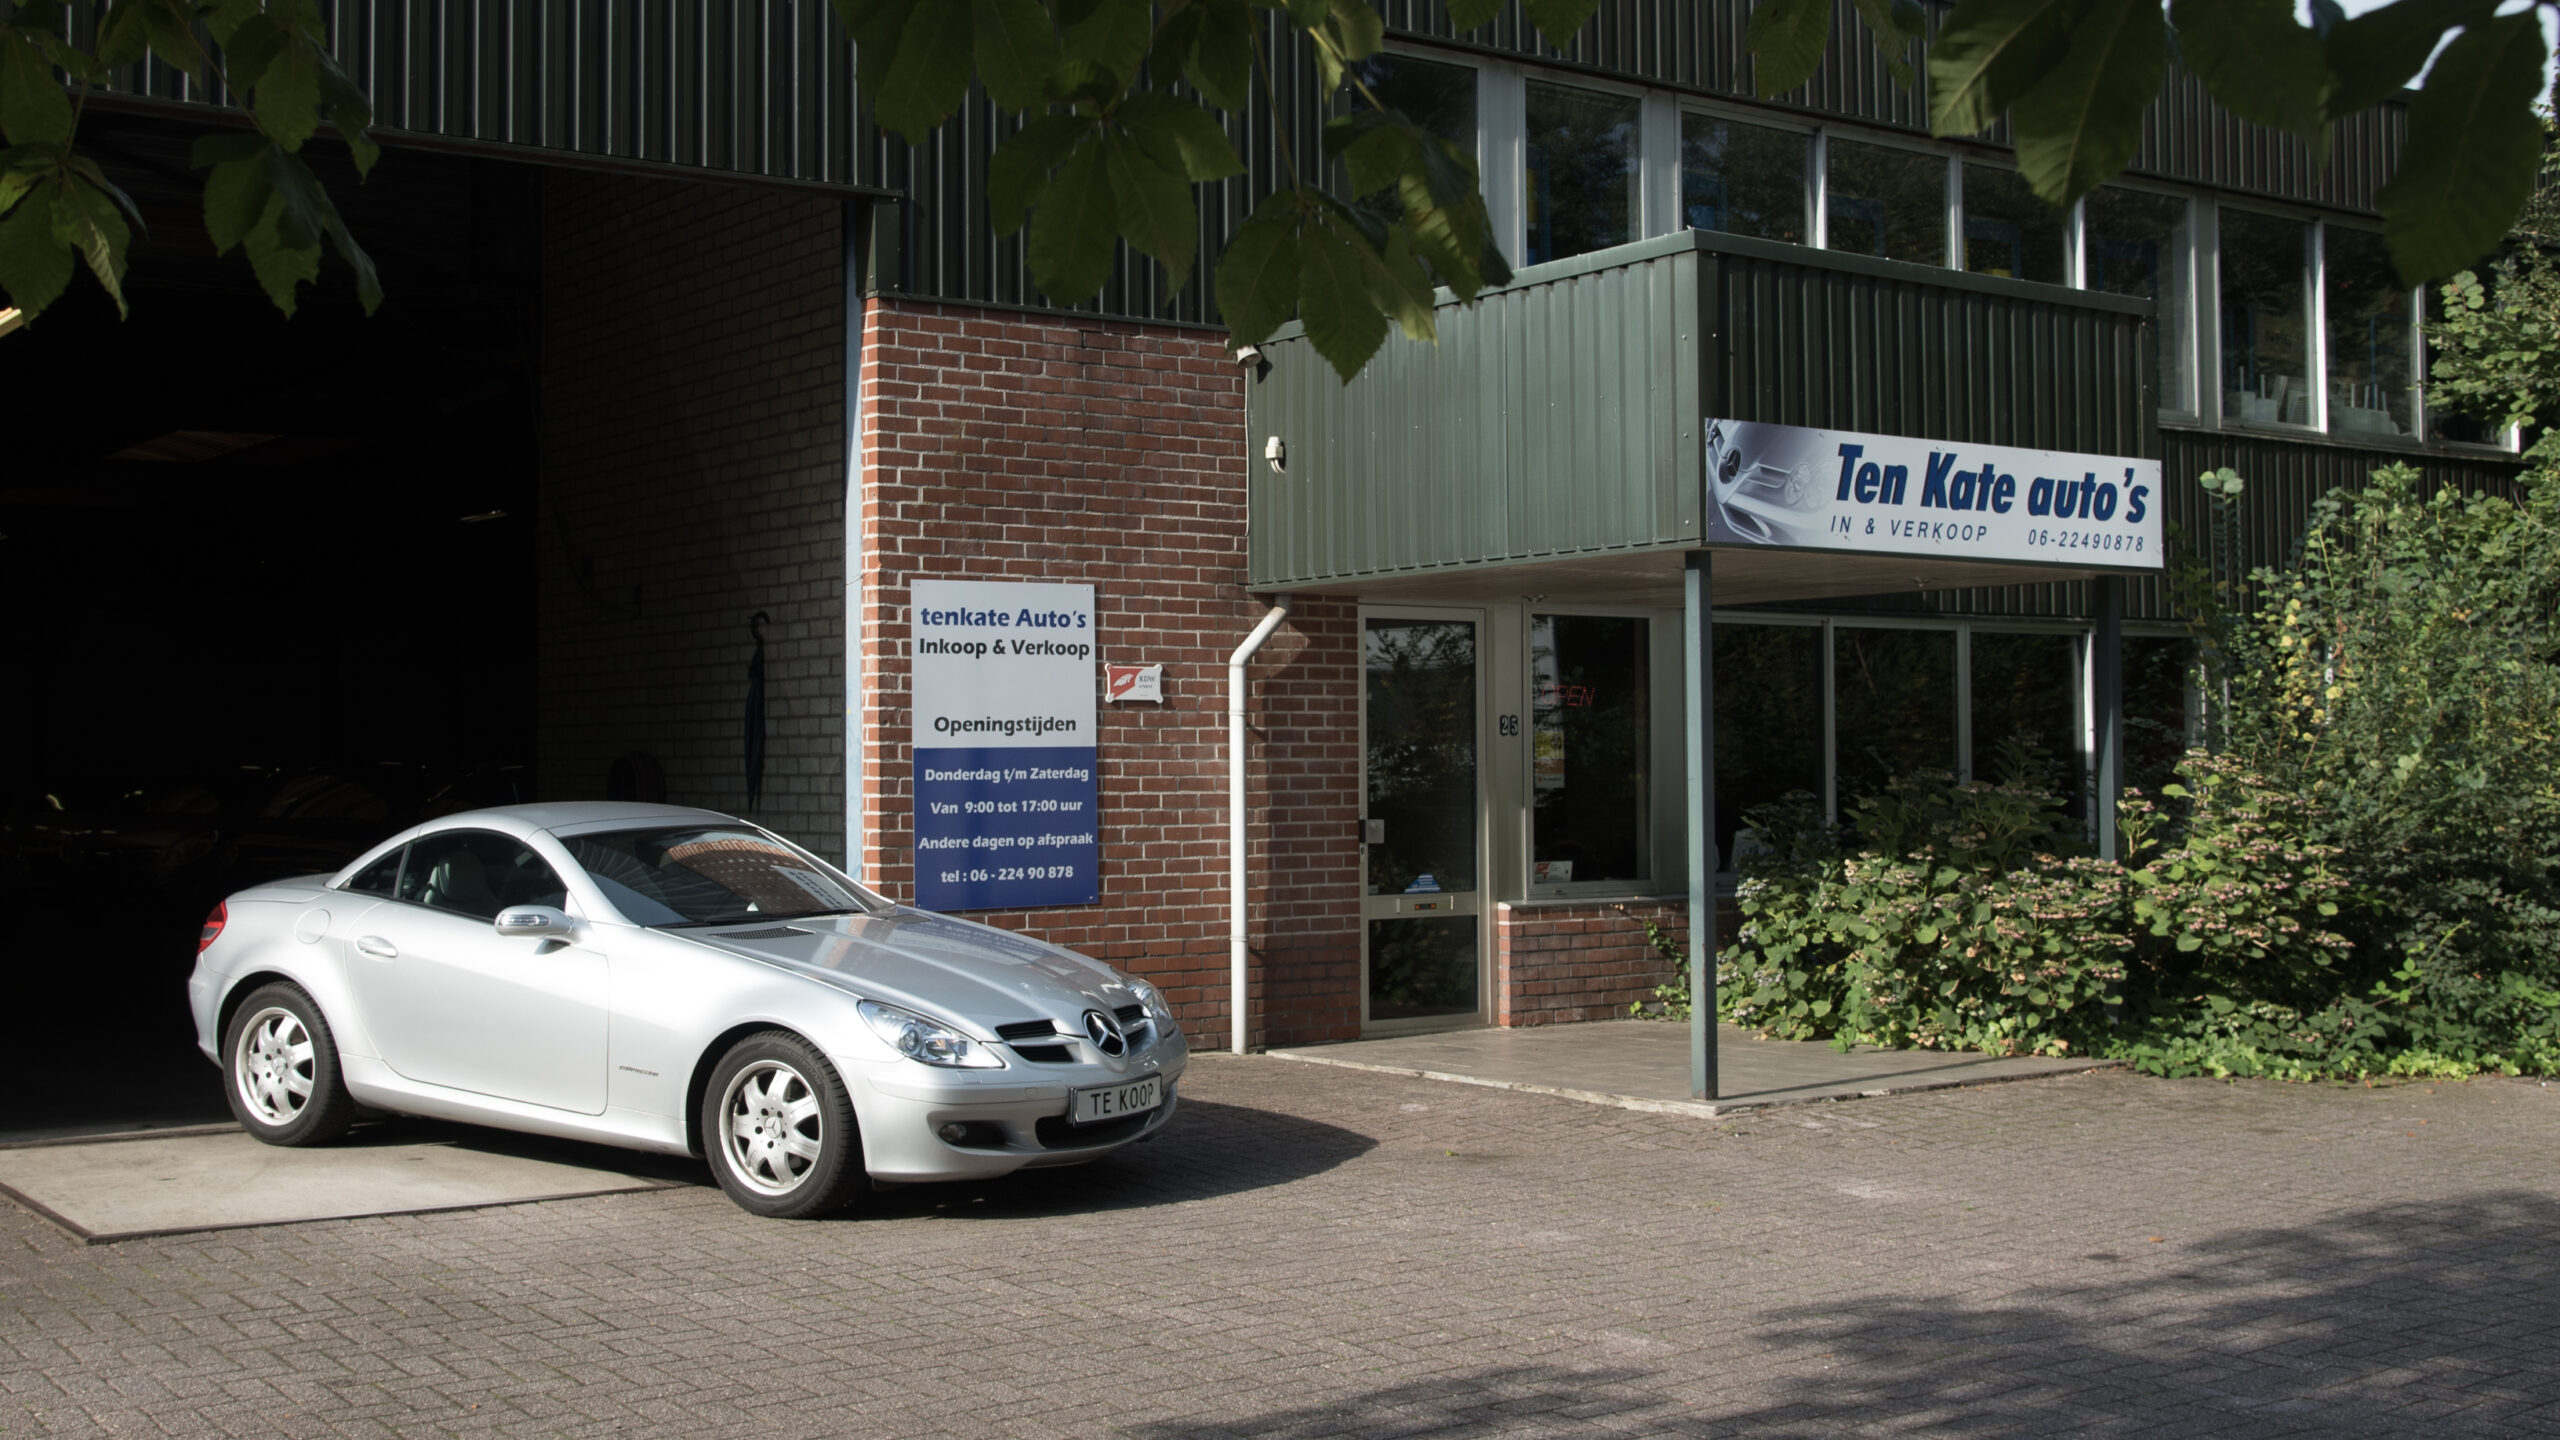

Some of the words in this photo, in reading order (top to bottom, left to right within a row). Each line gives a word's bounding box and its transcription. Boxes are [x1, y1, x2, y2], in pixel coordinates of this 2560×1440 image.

[1835, 442, 1909, 506] Ten
[1920, 451, 2016, 514] Kate
[2027, 467, 2150, 524] auto's
[1830, 515, 1852, 533] IN
[1865, 517, 1875, 535] &
[1890, 519, 1987, 542] VERKOOP
[2028, 528, 2144, 553] 06-22490878
[920, 607, 1010, 627] tenkate
[1015, 608, 1087, 629] Auto's
[919, 638, 988, 660] Inkoop
[992, 638, 1006, 655] &
[1010, 639, 1090, 661] Verkoop
[1542, 684, 1595, 707] OPEN
[933, 716, 1077, 737] Openingstijden
[1500, 715, 1518, 736] 25
[924, 768, 1001, 784] Donderdag
[1003, 767, 1028, 783] t/m
[1029, 767, 1089, 782] Zaterdag
[930, 802, 959, 815] Van
[964, 800, 995, 814] 9:00
[997, 801, 1018, 813] tot
[1021, 799, 1058, 812] 17:00
[1060, 801, 1083, 812] uur
[918, 836, 970, 850] Andere
[972, 835, 1015, 851] dagen
[1017, 836, 1035, 850] op
[1037, 832, 1093, 849] afspraak
[940, 869, 960, 883] tel
[969, 868, 989, 882] 06
[998, 867, 1025, 881] 224
[1027, 866, 1045, 880] 90
[1047, 865, 1074, 879] 878
[1091, 1091, 1112, 1116] TE
[1119, 1082, 1154, 1113] KOOP
